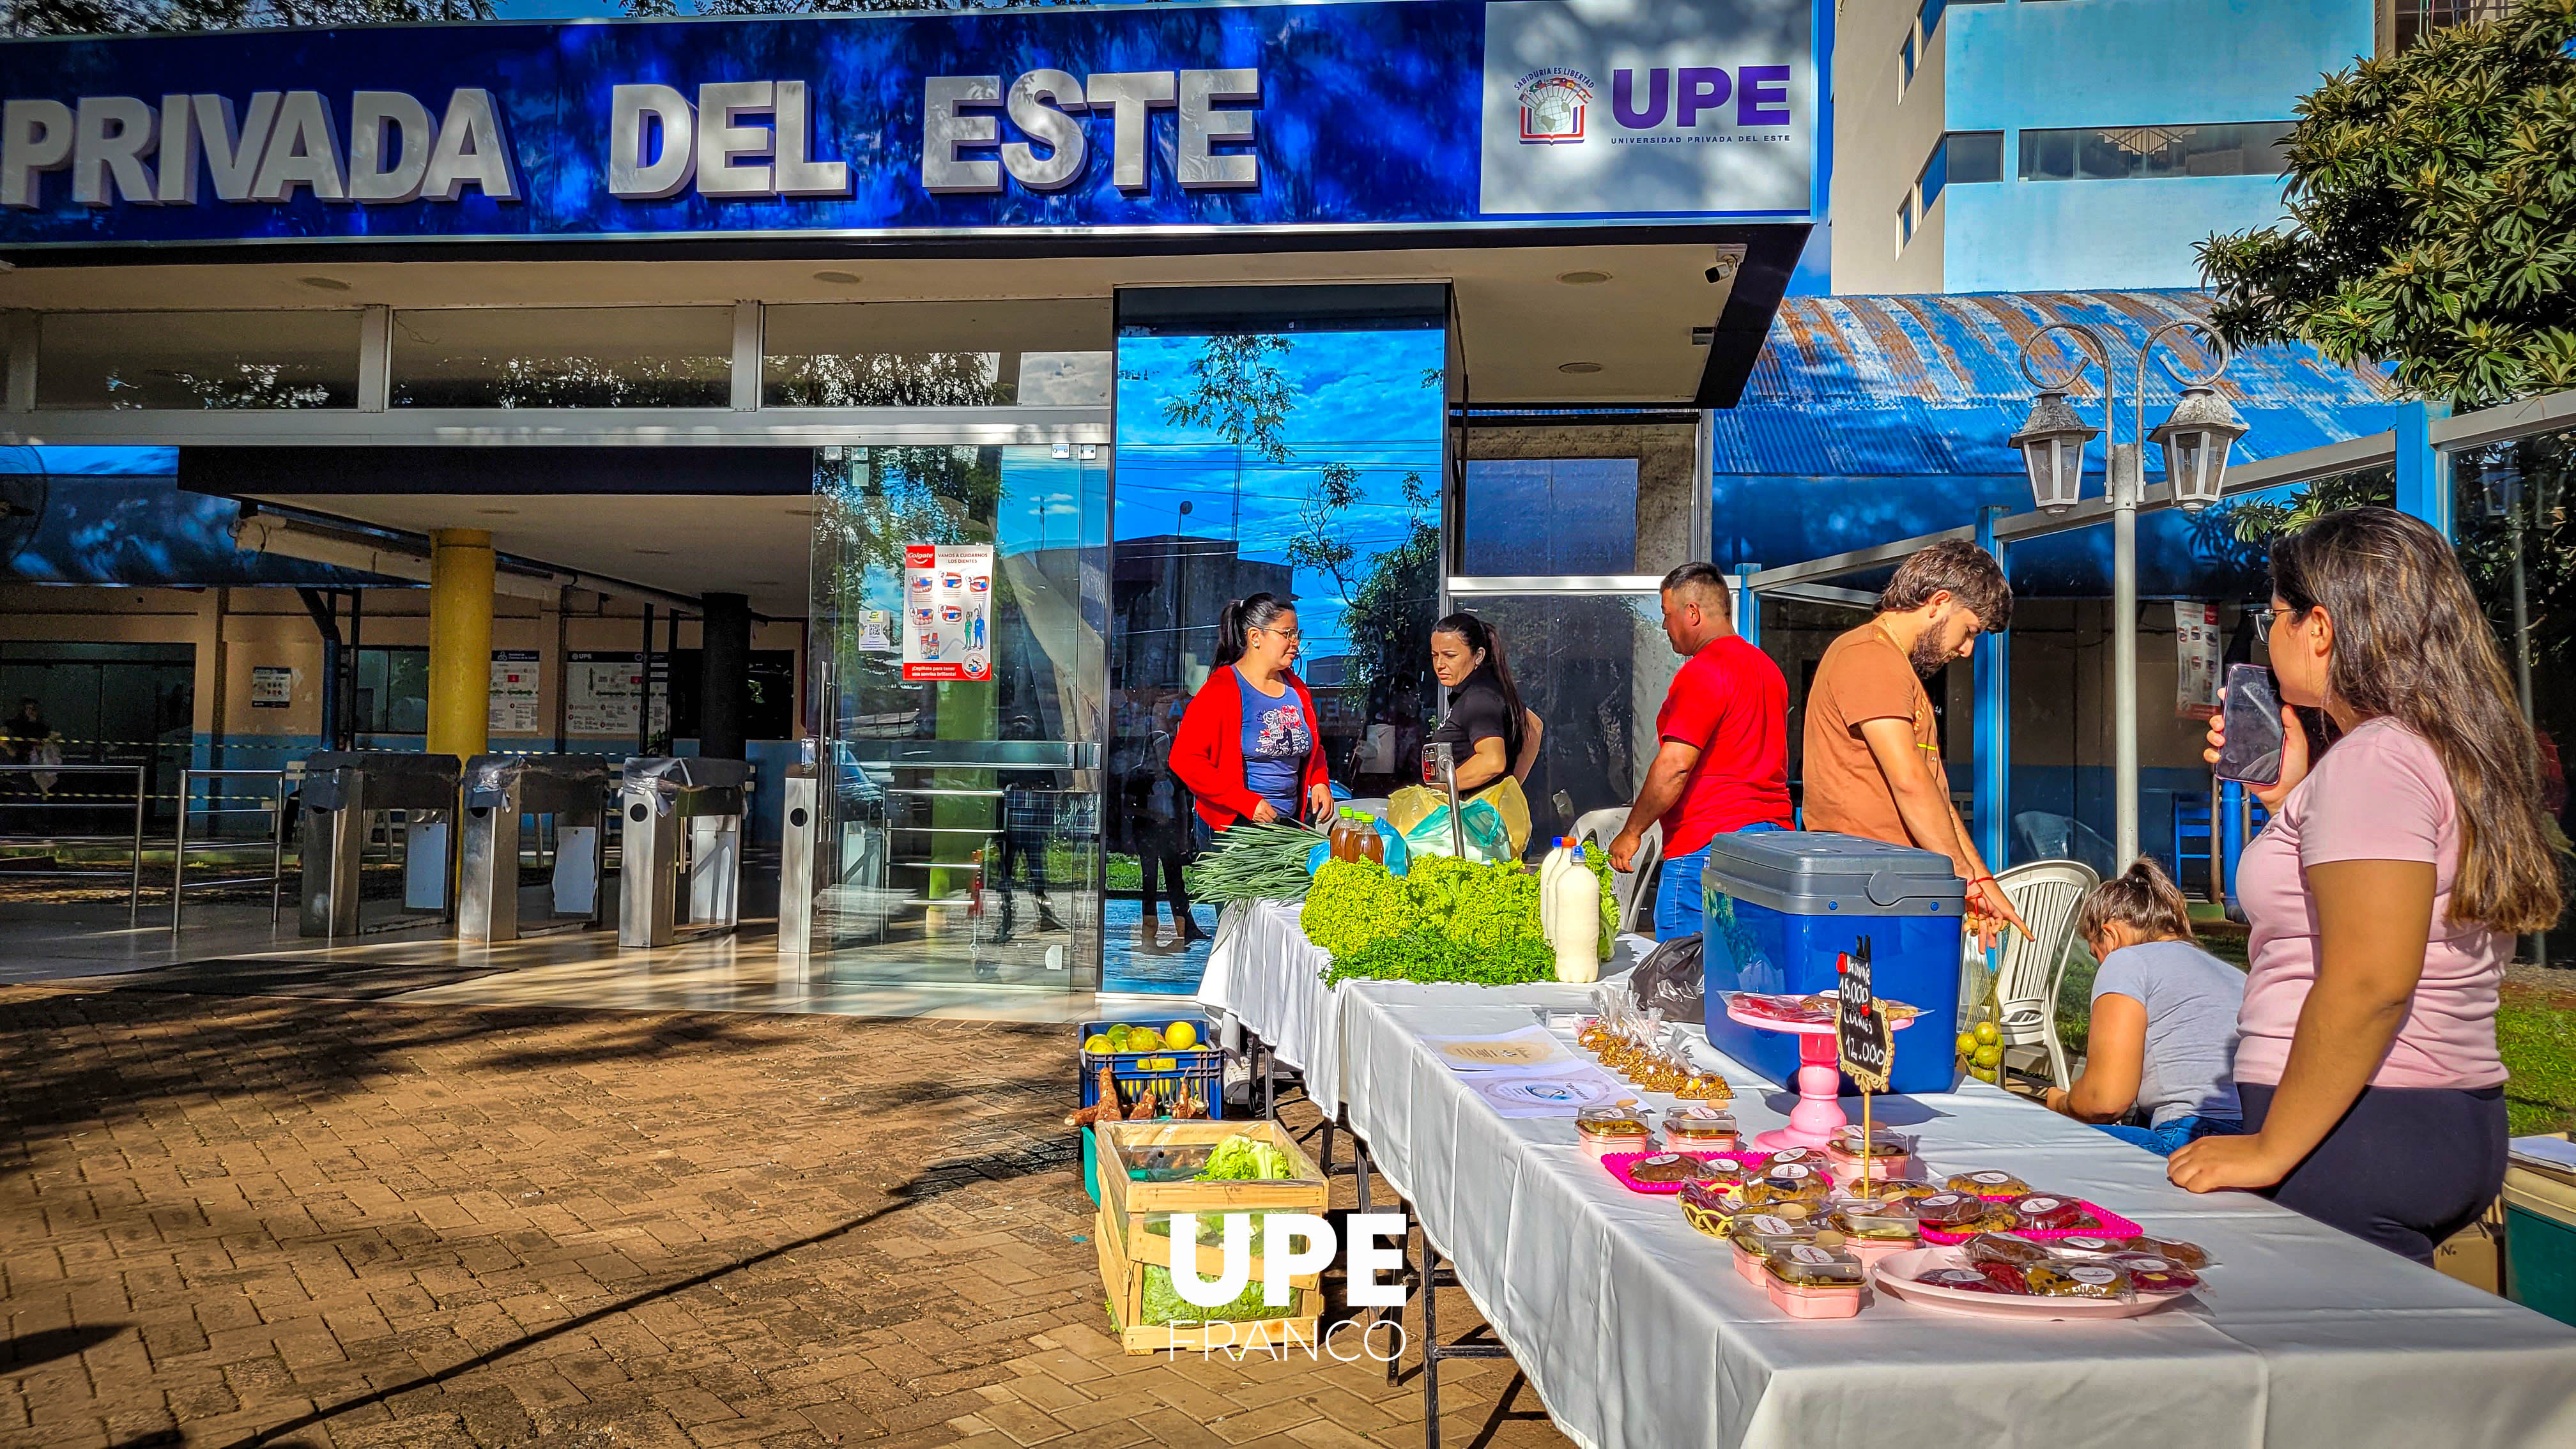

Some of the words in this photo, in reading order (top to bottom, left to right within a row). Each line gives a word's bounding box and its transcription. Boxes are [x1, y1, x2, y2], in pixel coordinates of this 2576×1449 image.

[1514, 67, 1552, 91] SABIDURIA
[1563, 67, 1595, 89] LIBERTAD
[1612, 65, 1790, 130] UPE
[1, 88, 519, 208] PRIVADA
[609, 80, 852, 199] DEL
[922, 68, 1260, 194] ESTE
[1839, 977, 1869, 1004] 15.000
[1846, 1034, 1885, 1066] 12.000
